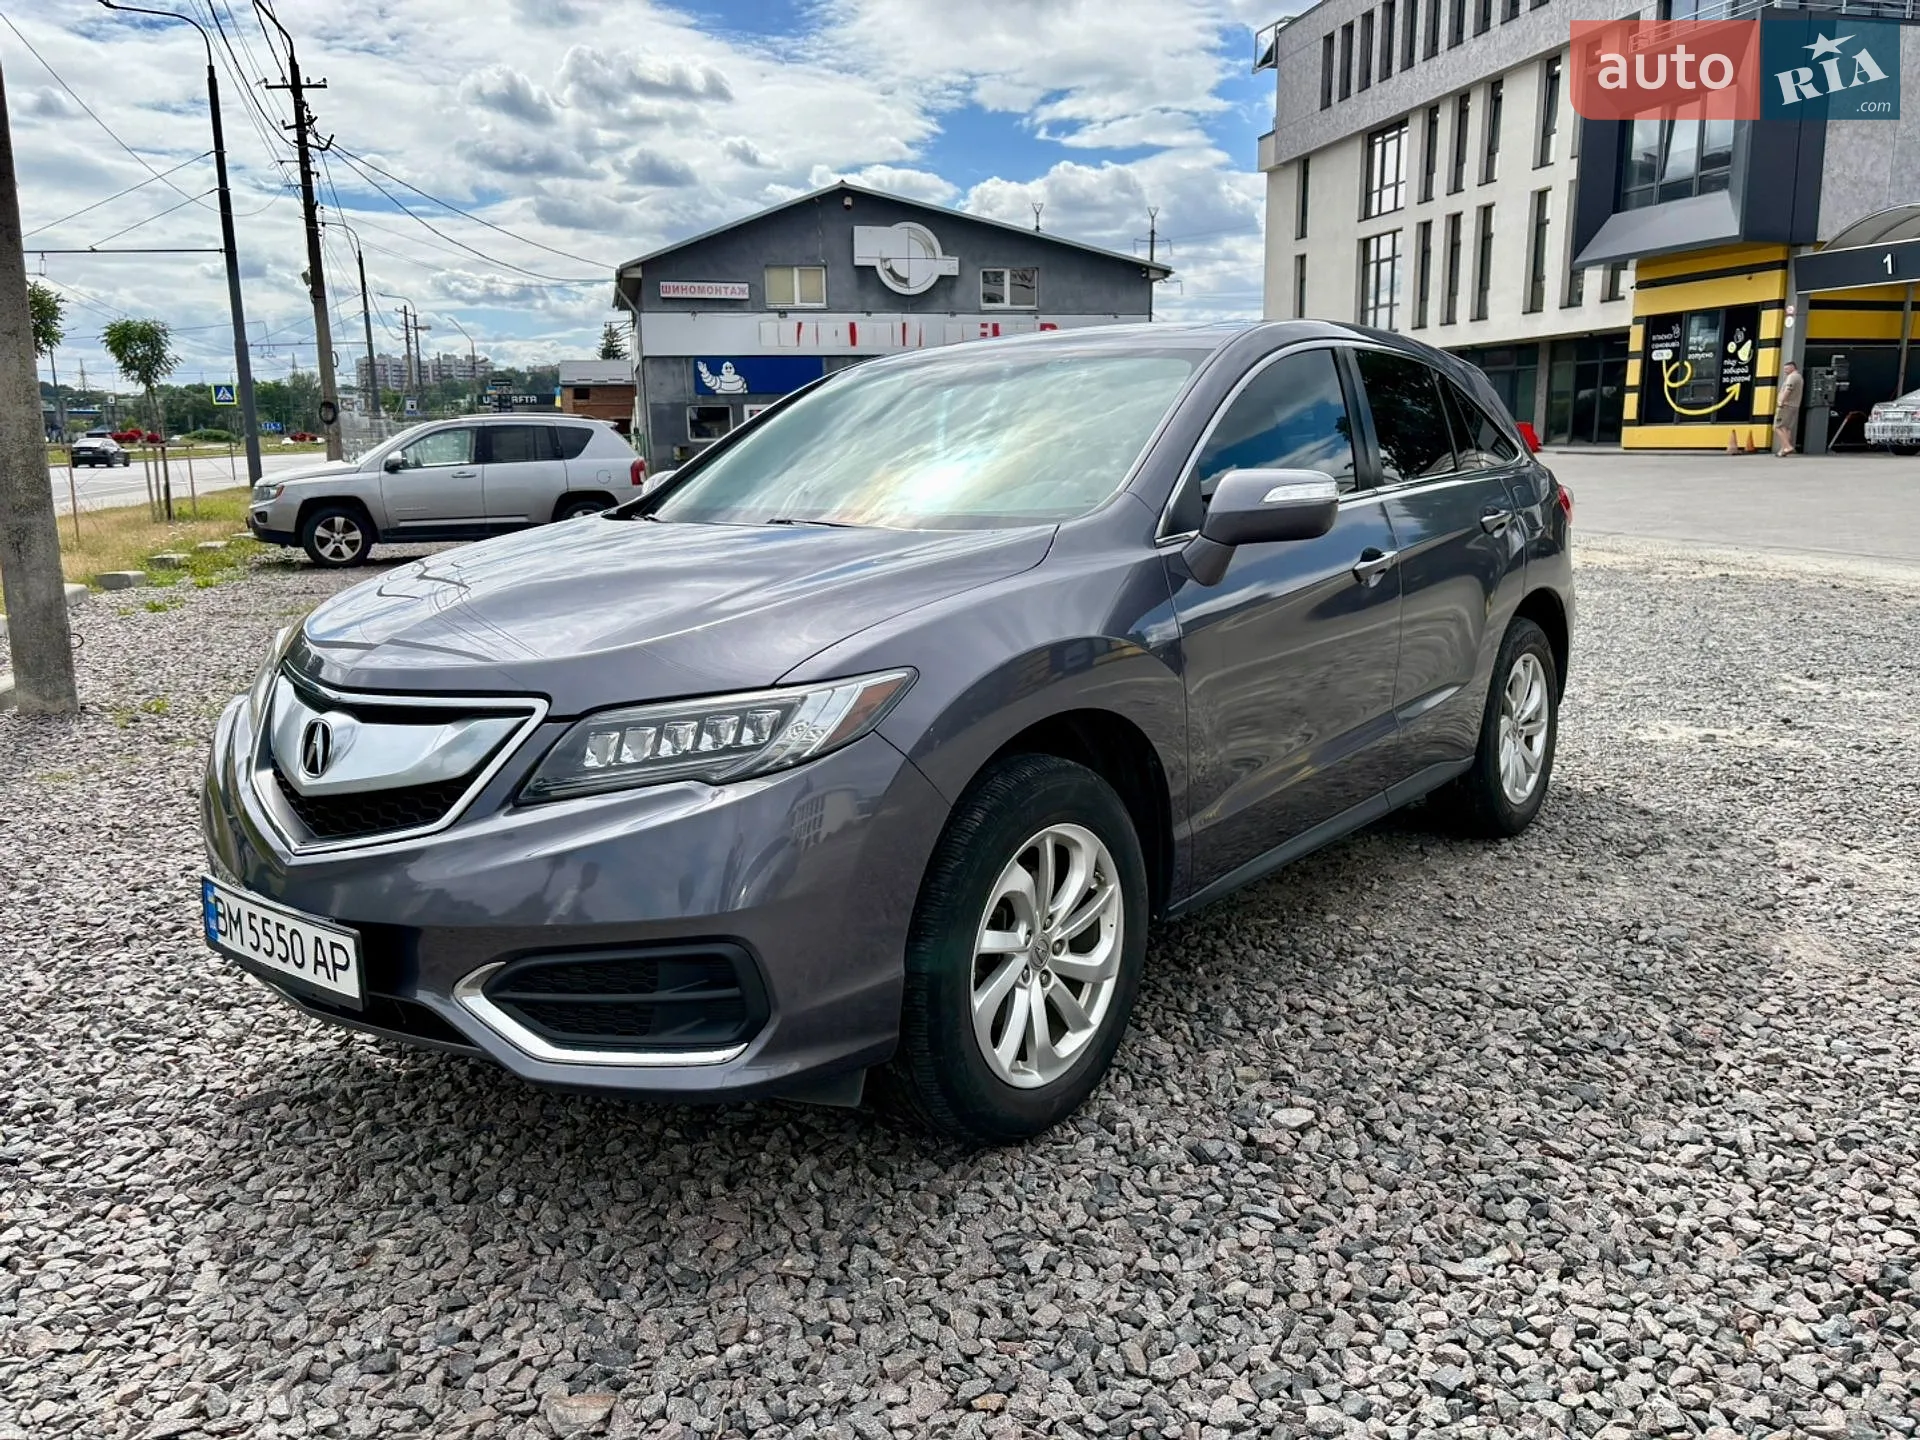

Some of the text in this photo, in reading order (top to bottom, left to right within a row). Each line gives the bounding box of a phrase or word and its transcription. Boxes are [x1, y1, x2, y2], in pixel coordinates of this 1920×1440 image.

[1883, 254, 1892, 274] 1
[662, 284, 748, 297] ШИНОМОНТАЖ
[248, 911, 305, 969] 5550
[313, 936, 350, 982] AP
